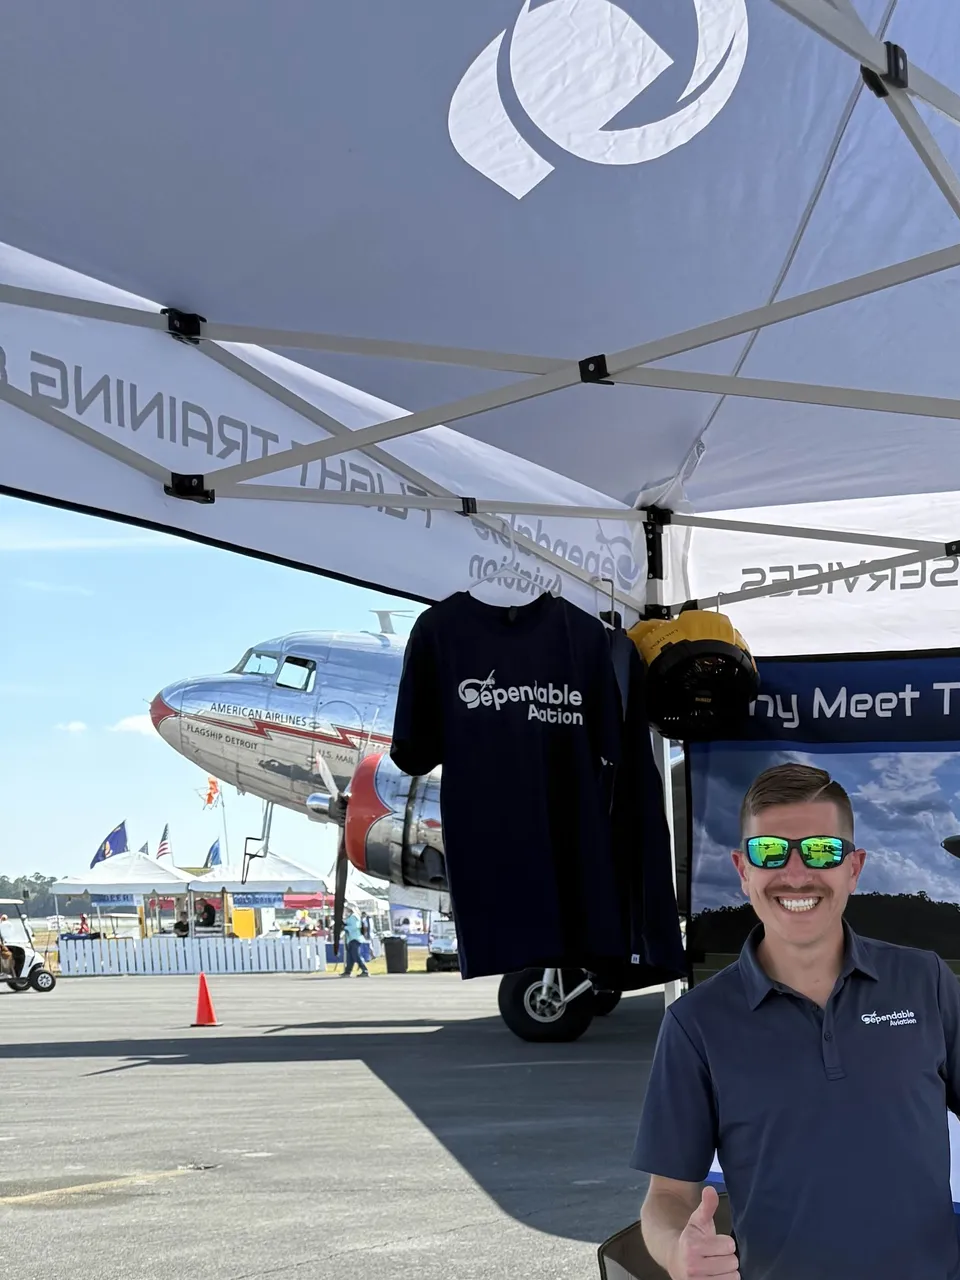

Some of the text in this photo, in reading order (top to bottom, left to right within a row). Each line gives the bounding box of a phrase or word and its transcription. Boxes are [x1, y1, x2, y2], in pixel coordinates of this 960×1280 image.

[210, 701, 307, 727] AMERICAN AIRLINES
[812, 683, 920, 720] Meet
[186, 723, 258, 751] FLAGSHIP DETROIT
[889, 1017, 917, 1027] Aviation
